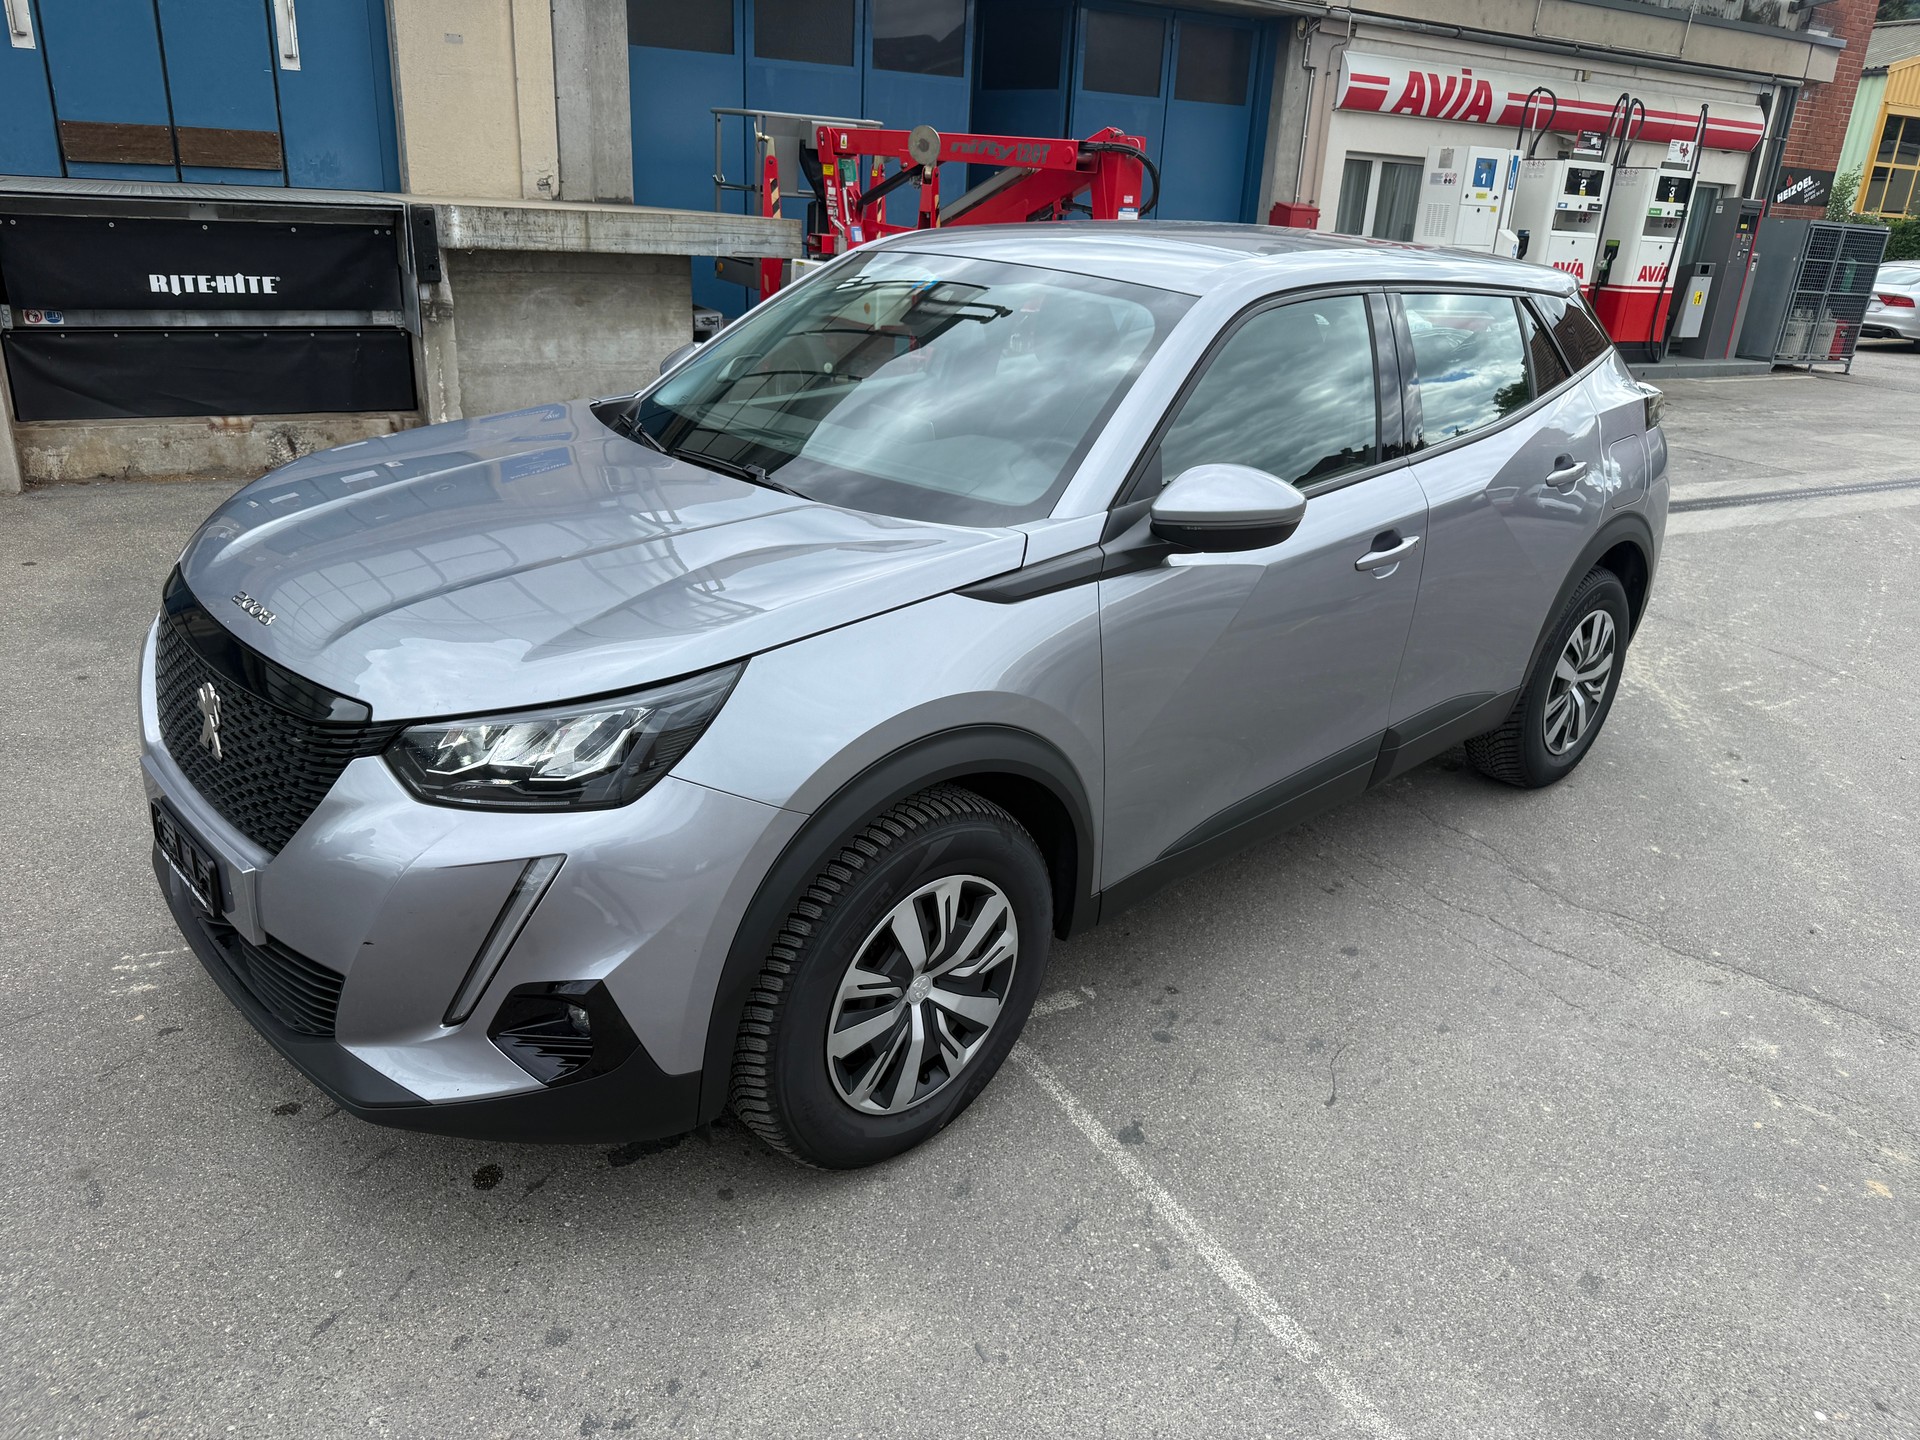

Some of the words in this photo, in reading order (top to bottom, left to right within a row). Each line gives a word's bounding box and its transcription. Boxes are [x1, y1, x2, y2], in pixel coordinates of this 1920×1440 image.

[1389, 67, 1493, 124] AVIA
[949, 138, 1016, 160] nifty
[1480, 172, 1487, 185] 1
[1579, 179, 1587, 190] 2
[1776, 175, 1814, 204] HEIZOEL
[1668, 187, 1676, 197] 3
[231, 591, 277, 627] 2008
